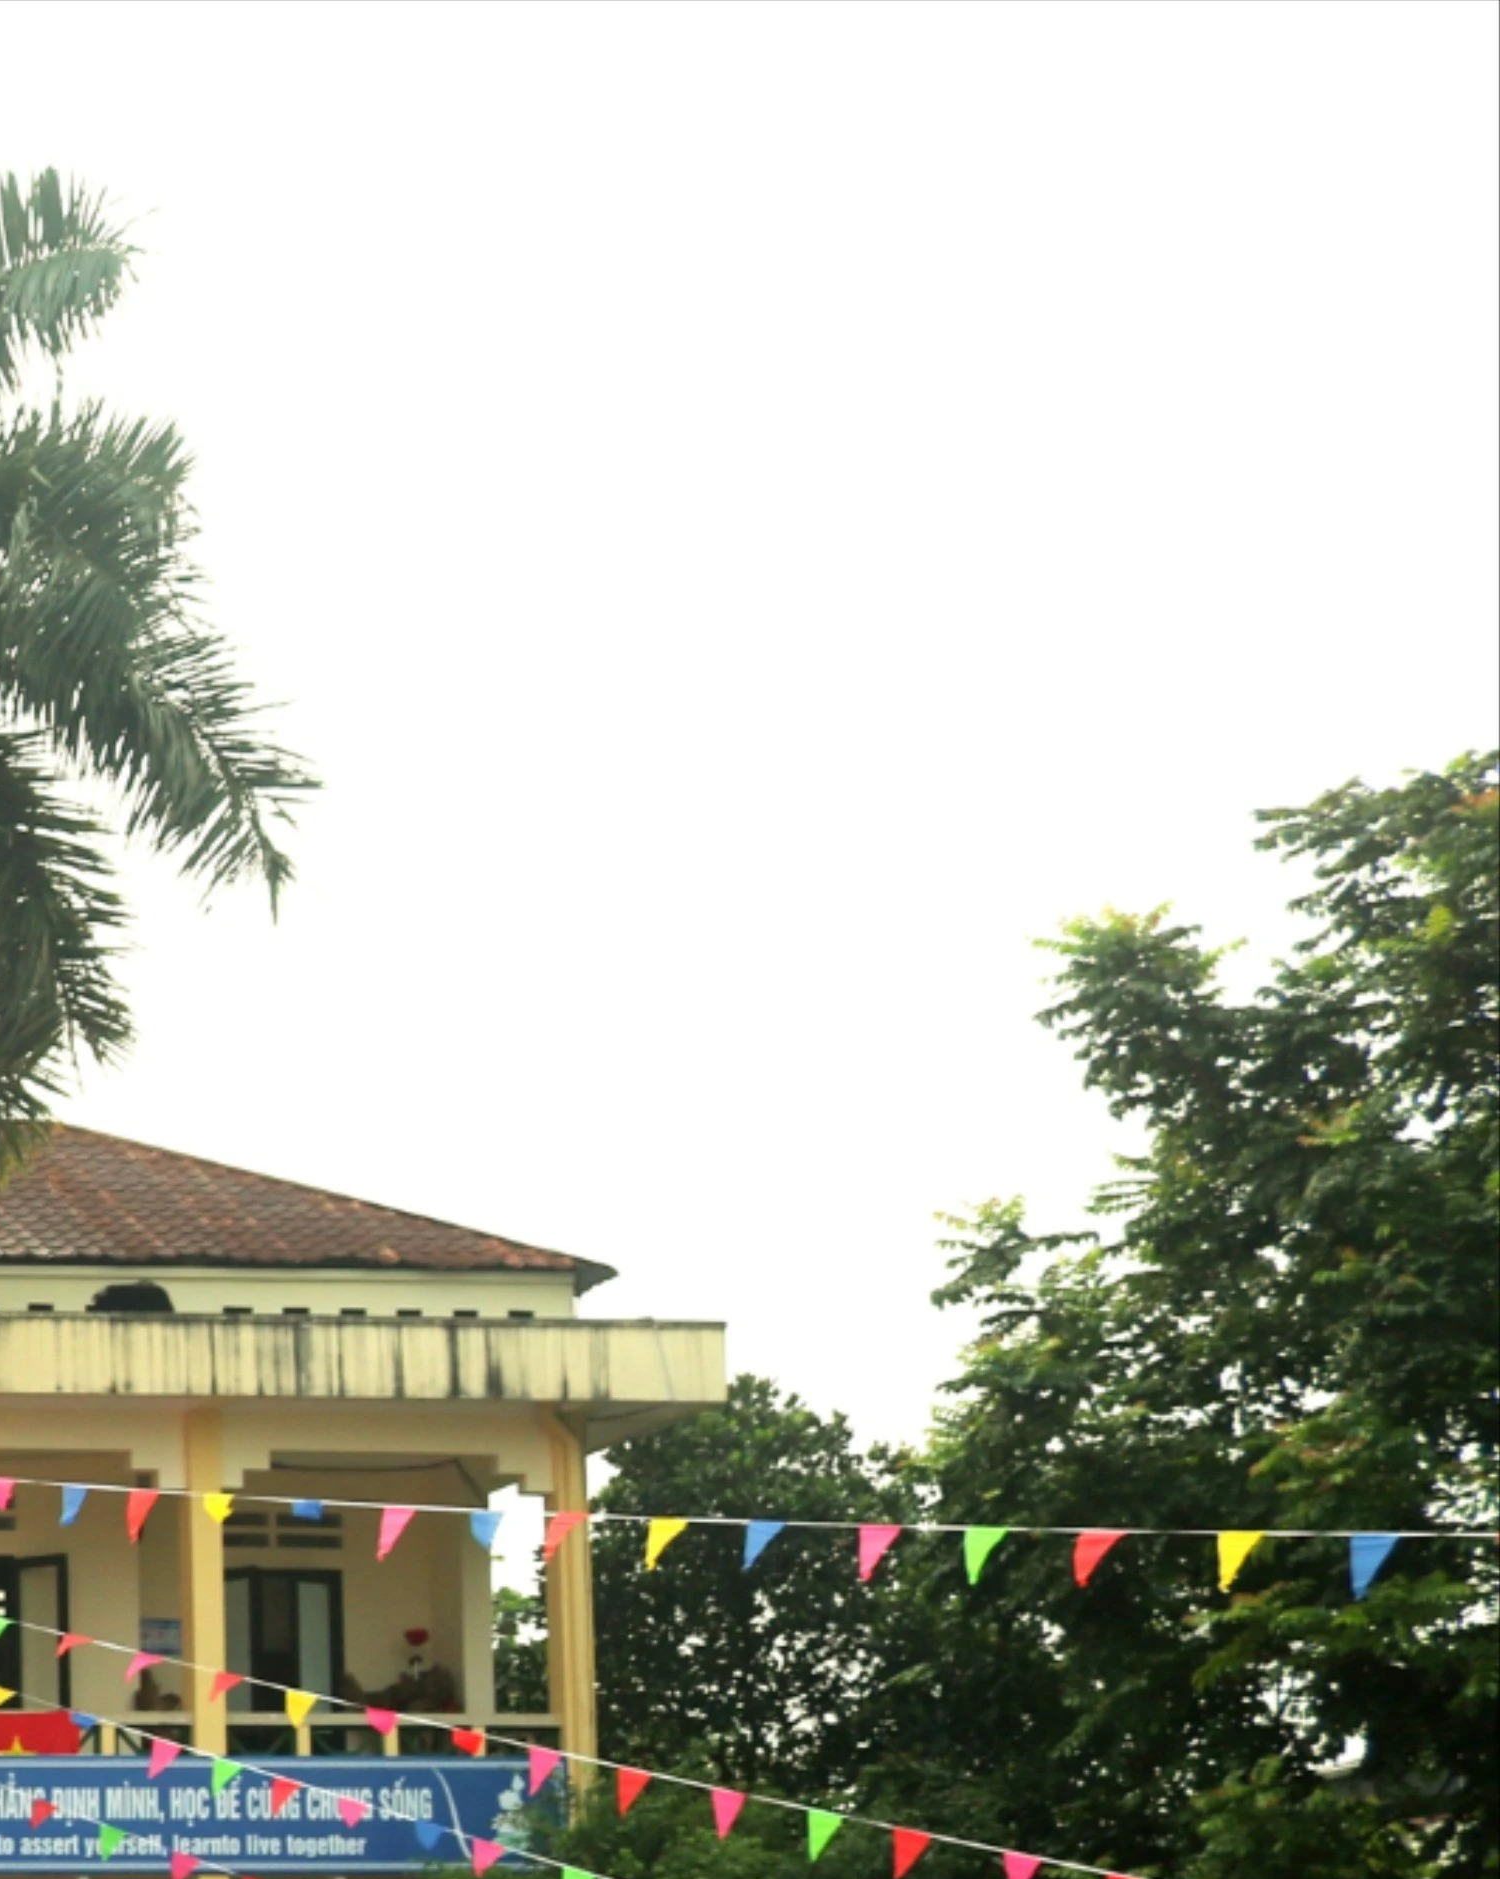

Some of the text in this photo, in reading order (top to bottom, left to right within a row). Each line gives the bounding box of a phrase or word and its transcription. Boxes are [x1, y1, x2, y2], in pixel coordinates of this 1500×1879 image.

[52, 1786, 101, 1827] ĐỊNH
[106, 1780, 165, 1823] MÌNH,
[170, 1787, 210, 1827] HỌC
[379, 1776, 432, 1822] SỐNG
[20, 1835, 79, 1855] assert
[247, 1835, 281, 1855] live
[287, 1835, 367, 1858] together
